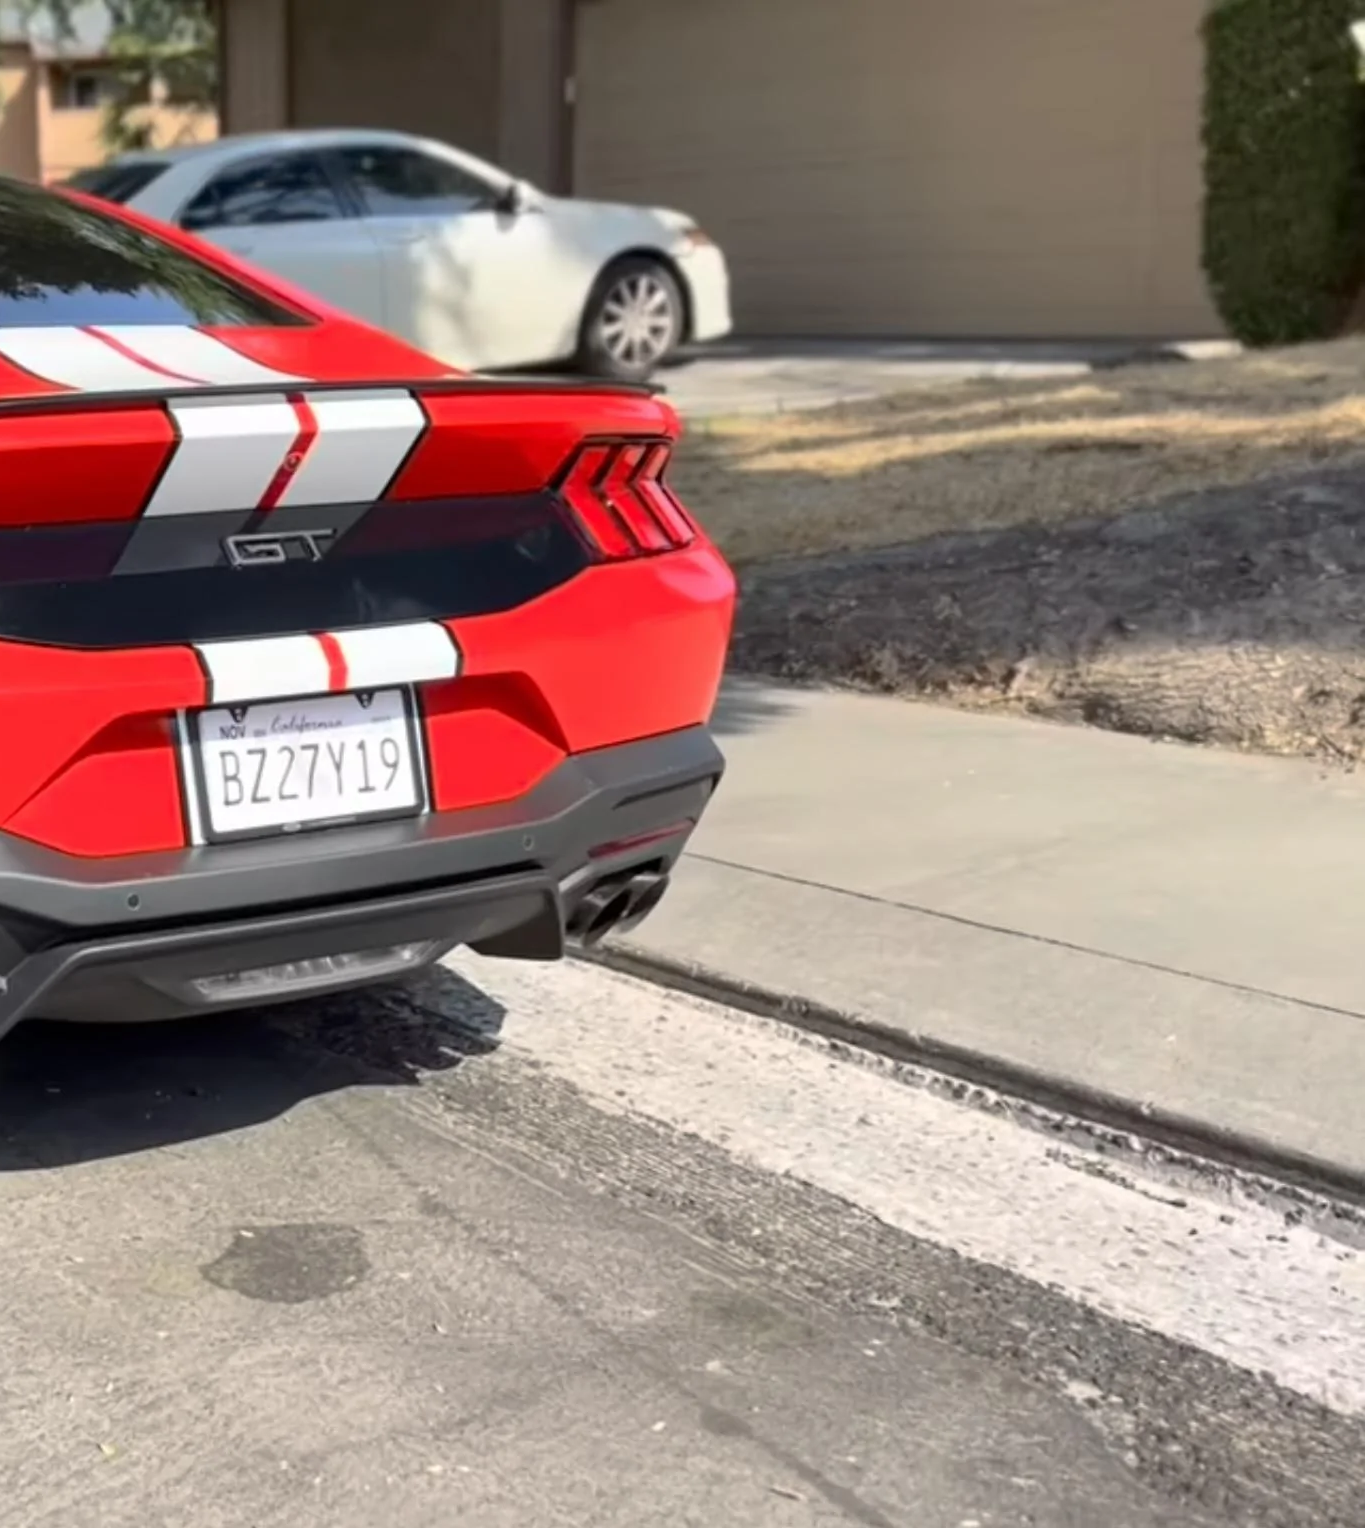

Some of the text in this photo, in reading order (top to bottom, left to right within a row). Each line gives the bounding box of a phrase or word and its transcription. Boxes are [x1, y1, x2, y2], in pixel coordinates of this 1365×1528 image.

[224, 528, 336, 568] GT
[219, 725, 246, 740] NOV
[270, 713, 343, 734] California
[219, 737, 401, 807] BZ27Y19
